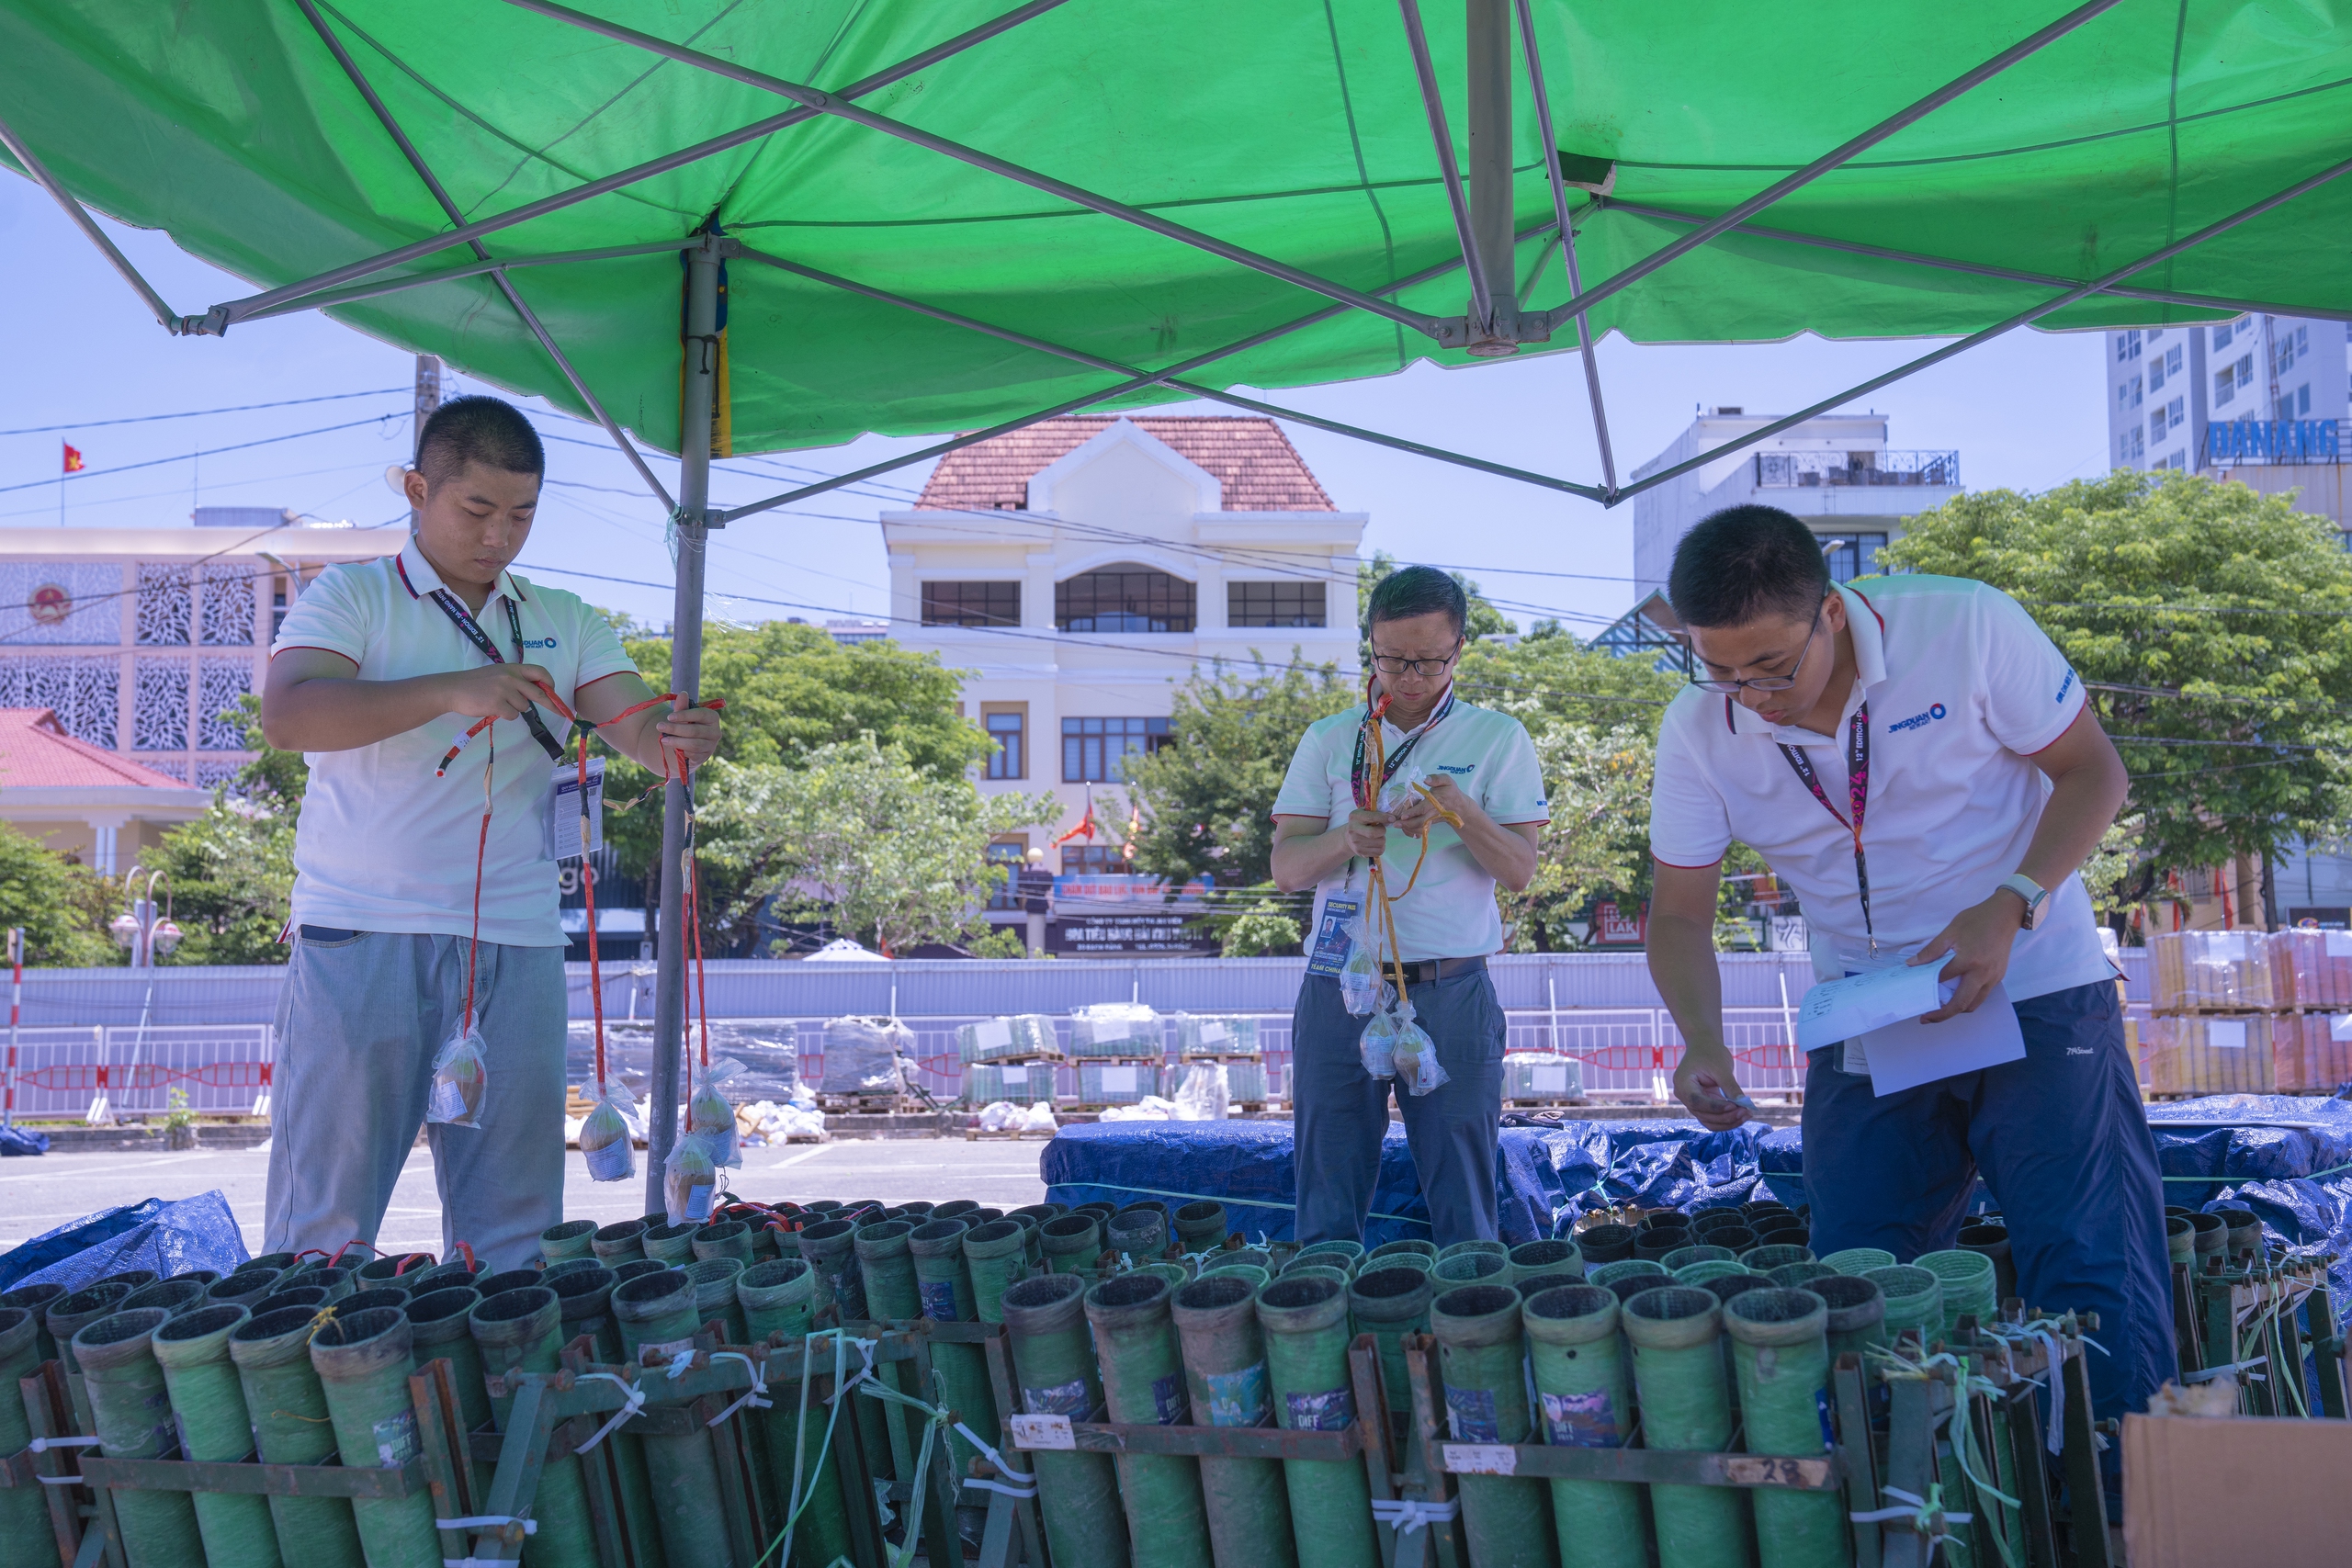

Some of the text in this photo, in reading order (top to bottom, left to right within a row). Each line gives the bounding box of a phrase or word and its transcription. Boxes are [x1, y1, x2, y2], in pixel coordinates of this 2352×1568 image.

[2209, 420, 2338, 457] DANANG
[444, 598, 456, 613] NANG
[462, 618, 479, 636] EDITION
[1888, 712, 1930, 733] JINGDUAN
[1394, 748, 1408, 762] EDITION
[1351, 771, 1362, 806] 2024
[1849, 772, 1866, 828] 2024
[1328, 901, 1348, 909] SECURITY
[1610, 922, 1636, 935] LAK
[1324, 965, 1341, 974] CHINA
[1166, 1393, 1181, 1412] DIFF
[1297, 1414, 1319, 1427] DIFF
[391, 1432, 412, 1452] DIFF
